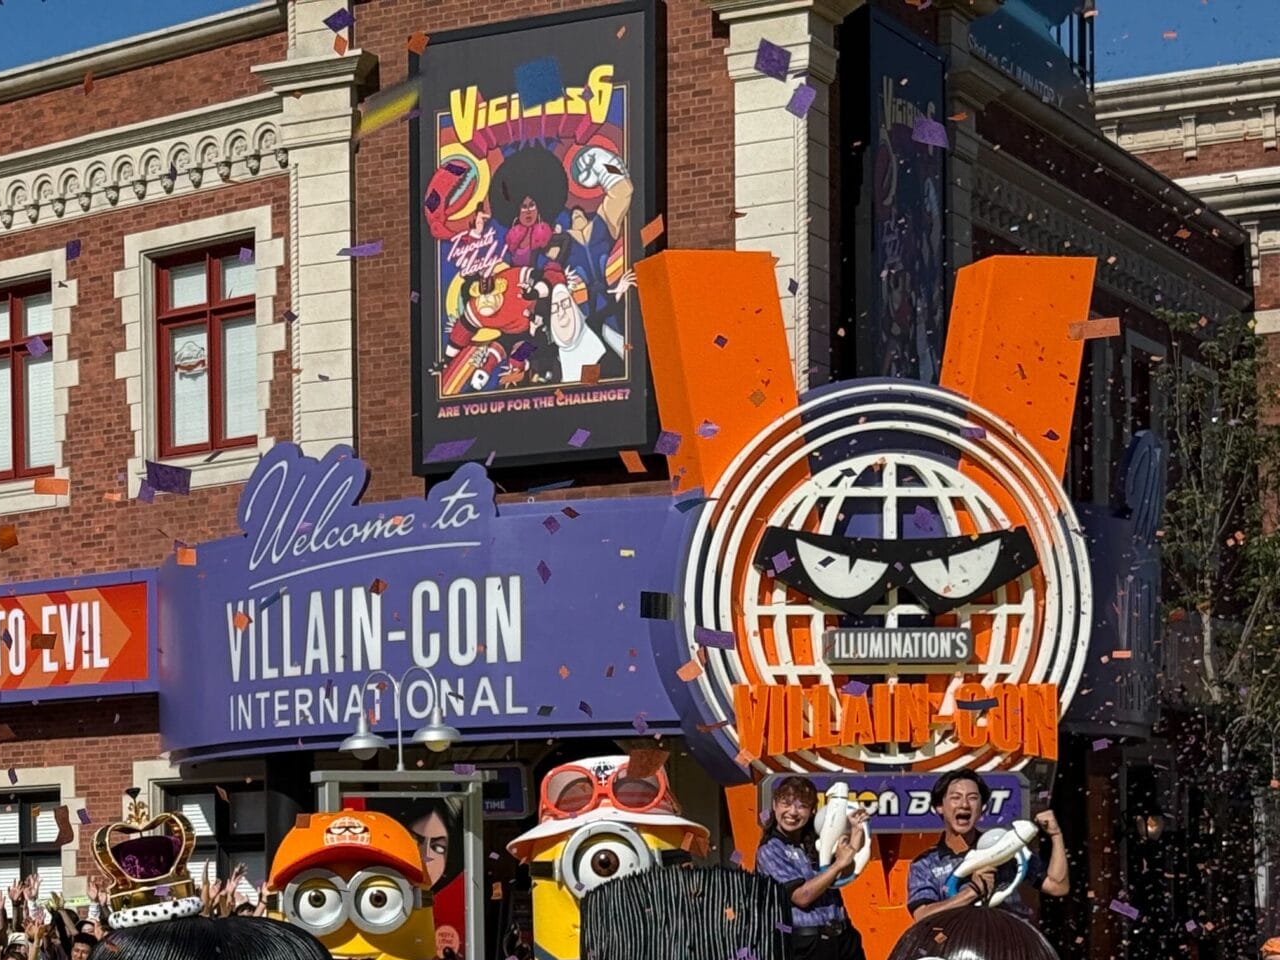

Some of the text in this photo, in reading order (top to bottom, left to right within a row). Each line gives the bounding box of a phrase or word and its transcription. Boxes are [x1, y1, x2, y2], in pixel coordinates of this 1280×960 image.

[447, 226, 497, 267] Tryouts
[437, 388, 631, 419] ARE YOU UP FOR THE CHALLENGE?
[244, 459, 481, 571] Welcome to
[41, 600, 110, 673] EVIL
[226, 574, 522, 683] VILLAIN-CON
[833, 631, 969, 660] ILLUMINATION'S
[229, 676, 529, 732] INTERNATIONAL
[732, 682, 1059, 762] VILLAIN-CON
